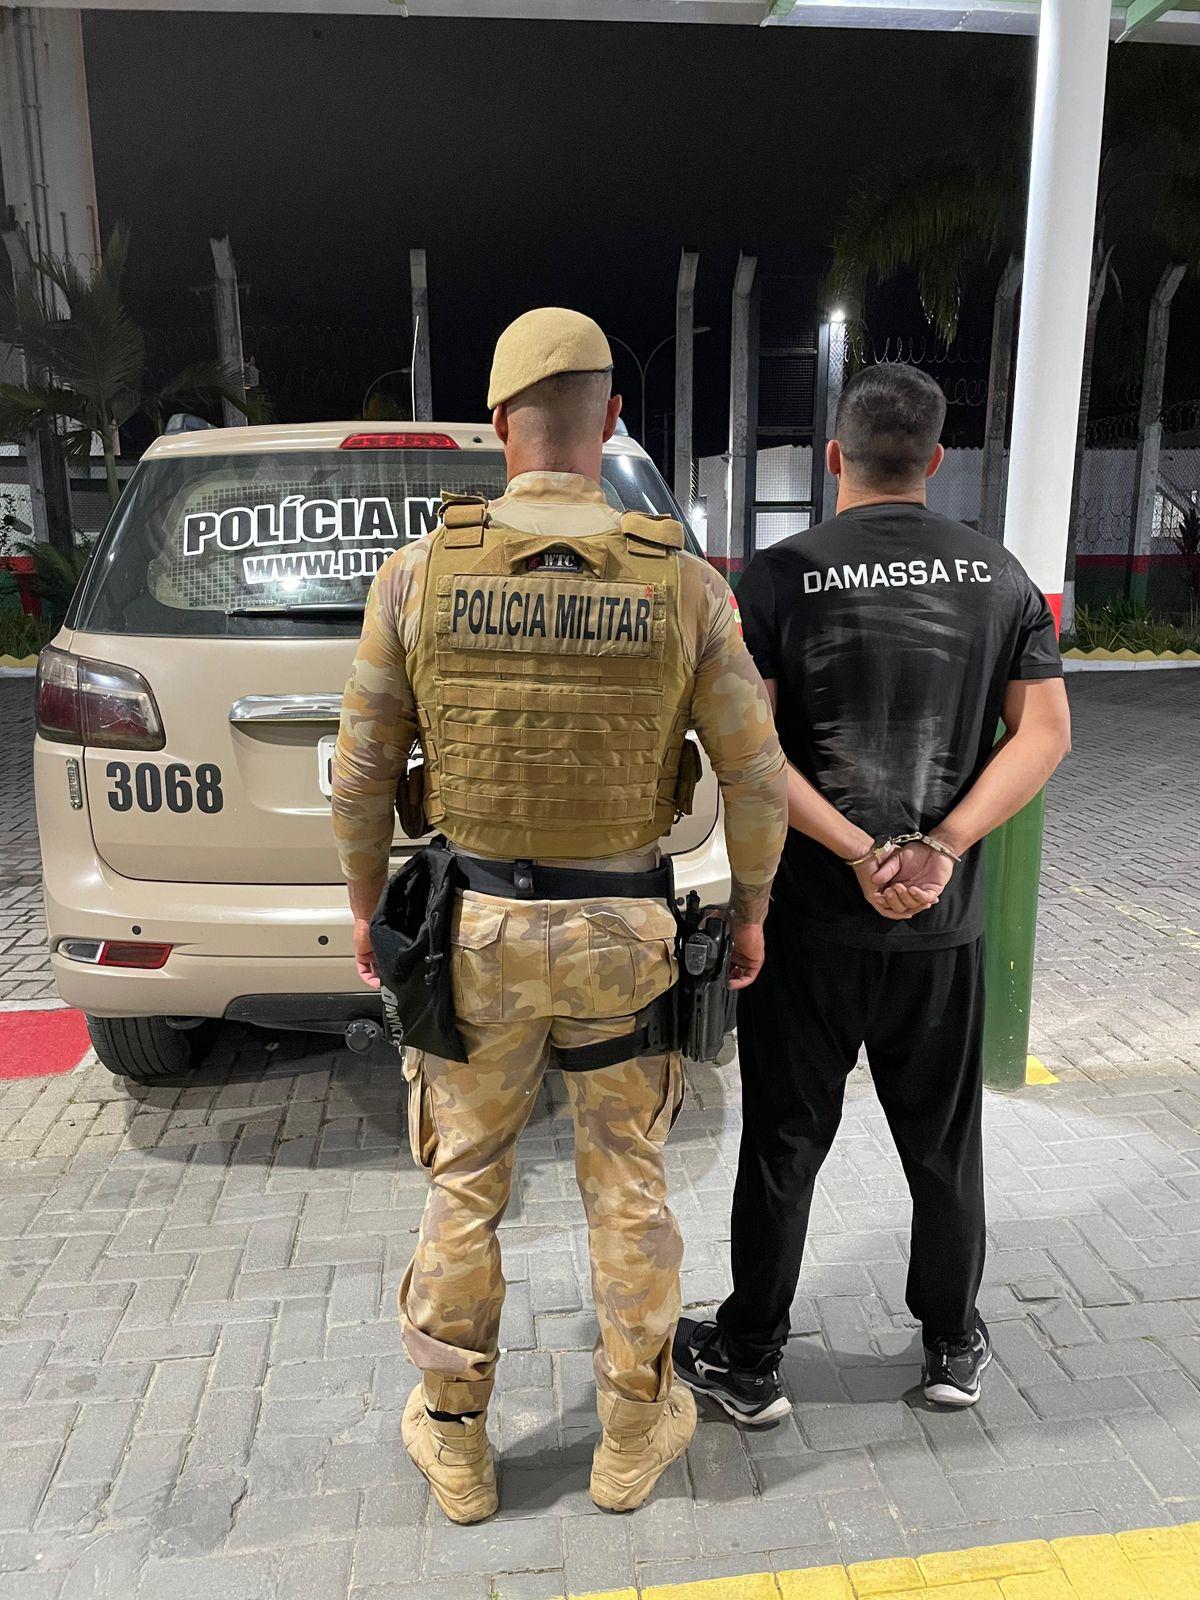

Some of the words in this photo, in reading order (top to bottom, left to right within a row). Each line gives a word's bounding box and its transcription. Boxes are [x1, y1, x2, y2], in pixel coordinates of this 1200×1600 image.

[183, 495, 398, 556] POLÍCIA
[543, 553, 575, 567] WTC
[803, 558, 951, 594] DAMASSA
[954, 558, 992, 583] F.C
[452, 581, 547, 638] POLÍCIA
[554, 593, 651, 643] MILITAR
[106, 761, 224, 814] 3068
